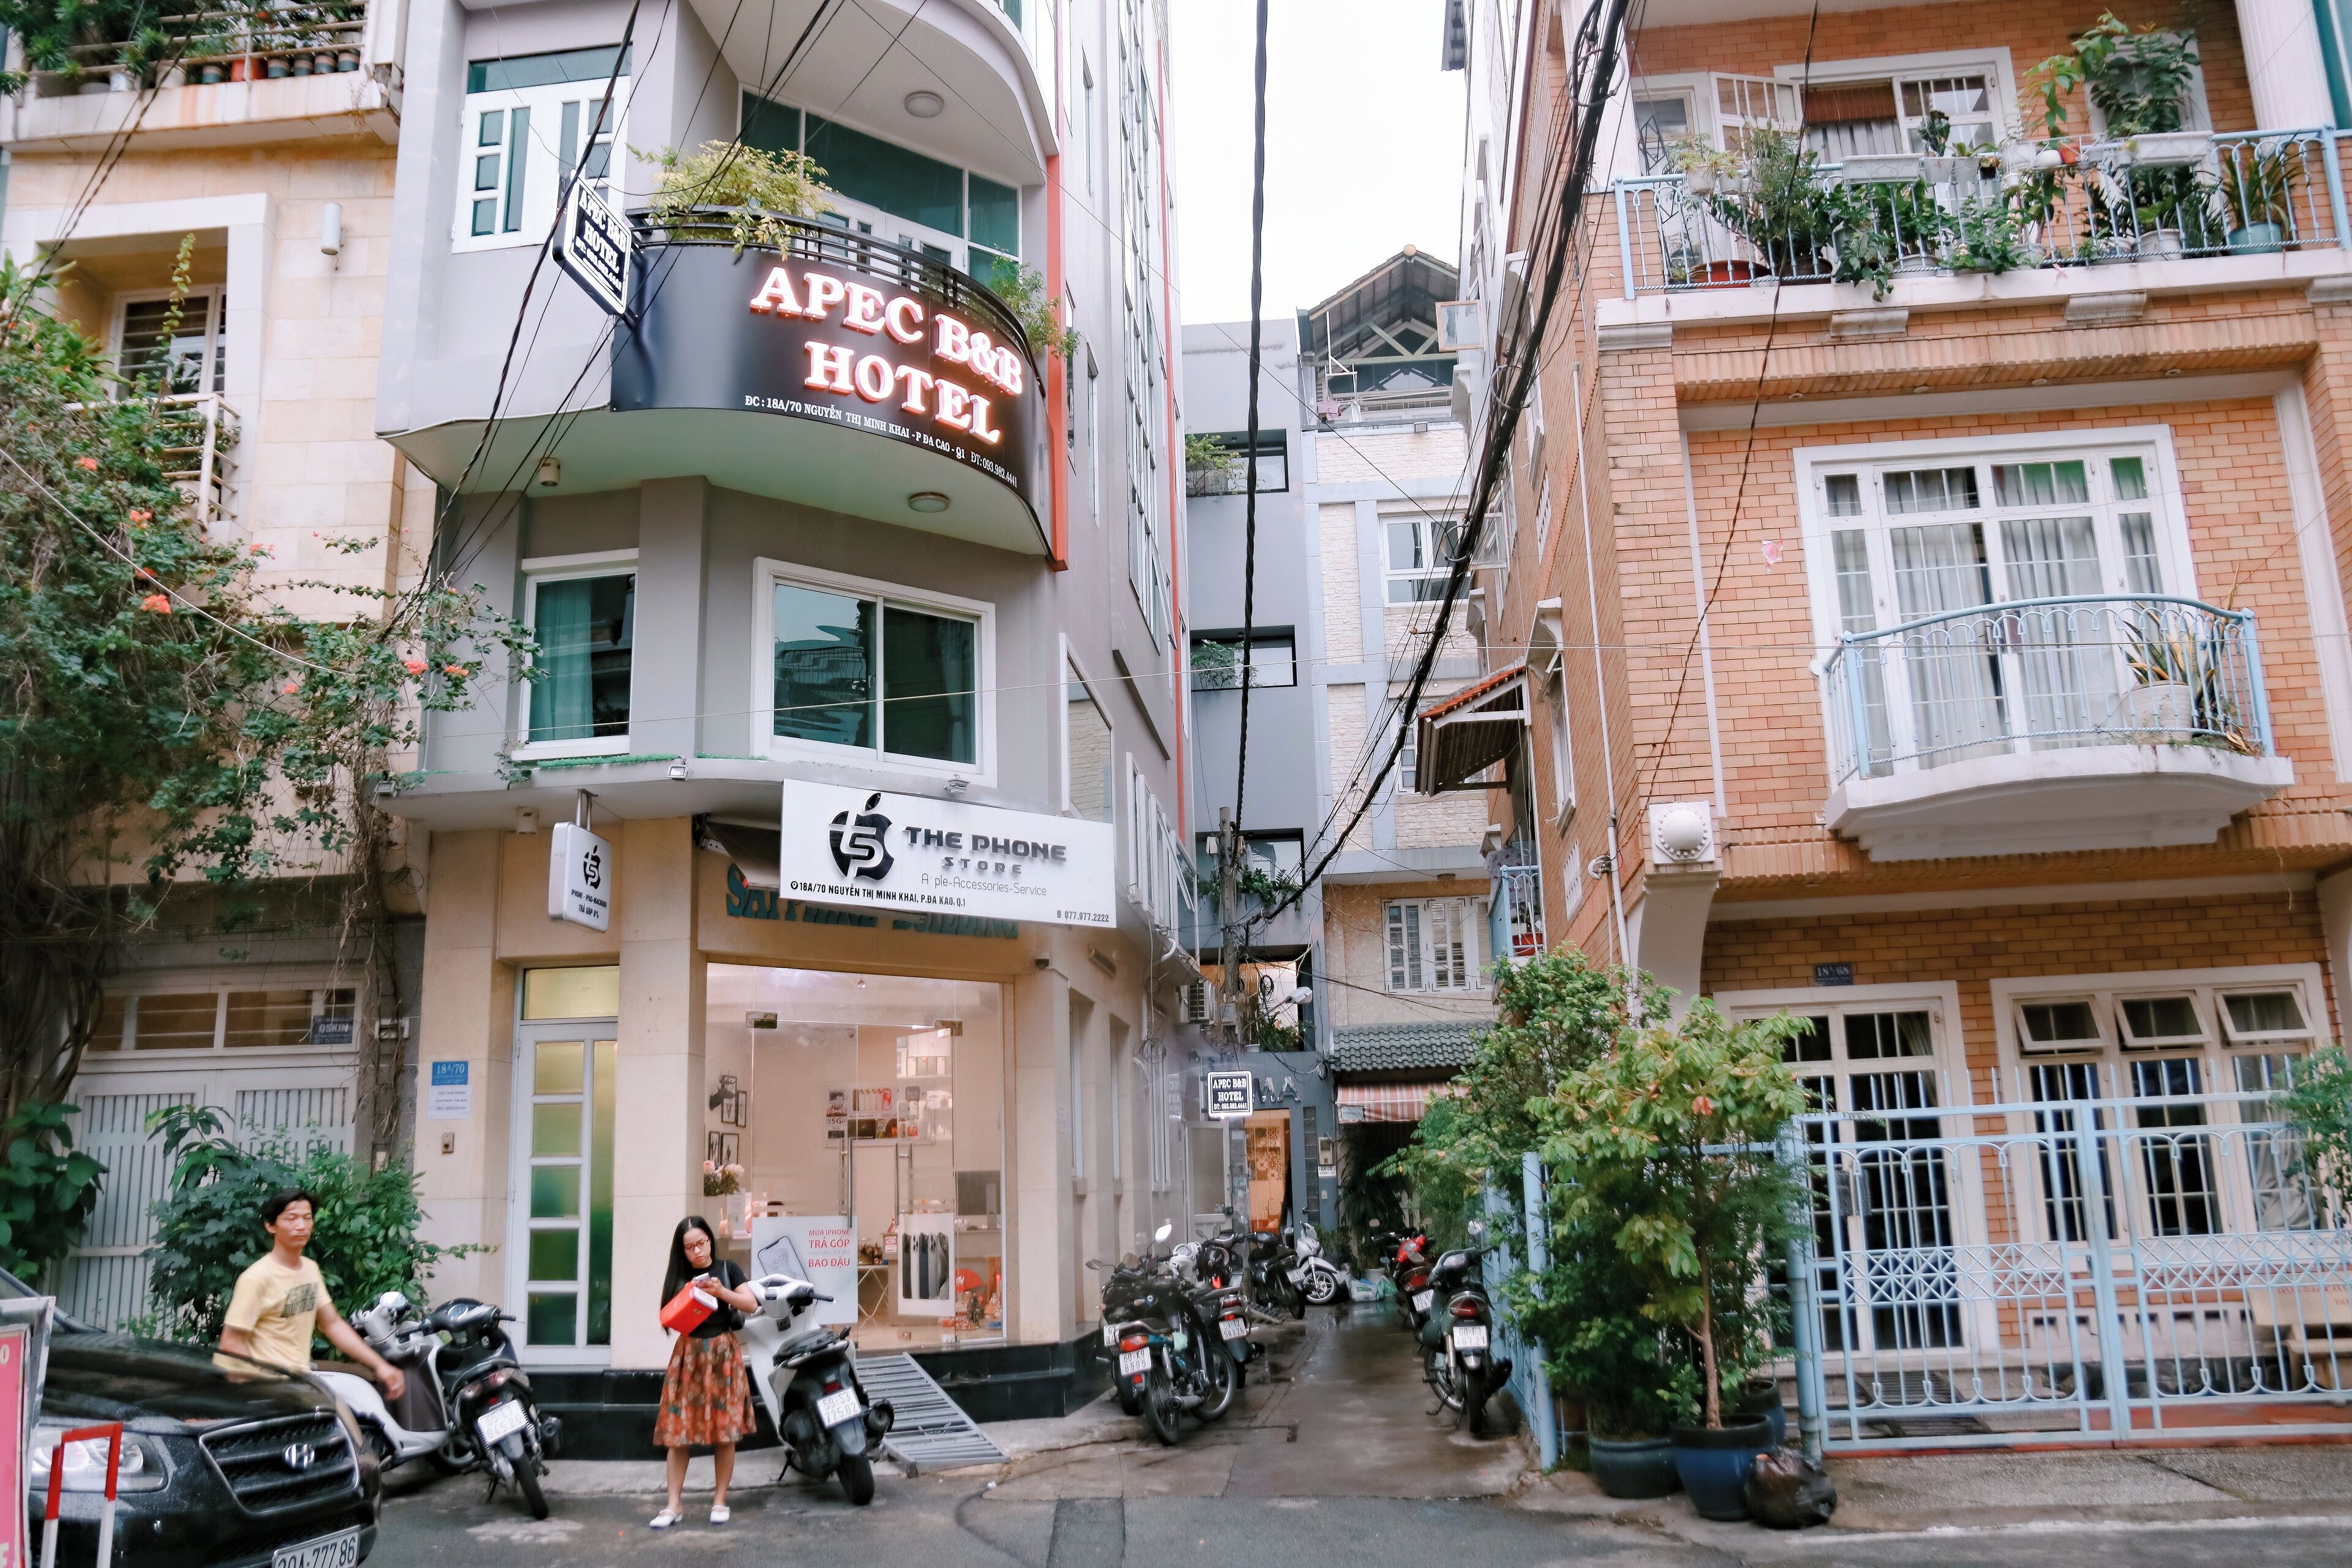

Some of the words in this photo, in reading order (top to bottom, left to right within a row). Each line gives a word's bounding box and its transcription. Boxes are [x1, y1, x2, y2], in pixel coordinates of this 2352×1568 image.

[579, 189, 606, 230] APEC
[607, 216, 627, 252] B&B
[584, 221, 619, 274] HOTEL
[750, 266, 924, 344] APEC
[934, 313, 1022, 396] B&B
[804, 341, 1001, 445] HOTEL
[767, 398, 802, 412] 18A/70
[804, 404, 842, 420] NGUYỄN
[846, 412, 861, 427] THỊ
[864, 416, 886, 432] MINH
[889, 423, 910, 439] KHAI
[923, 435, 934, 447] ĐA
[936, 439, 950, 452] CAO
[956, 447, 965, 459] Q1
[982, 458, 1017, 488] 093.982.4441
[903, 826, 962, 850] THE
[971, 834, 1066, 862] PHONE
[943, 856, 1022, 874] STORE
[921, 873, 1047, 896] Aple-Accessories-Service
[799, 882, 826, 893] 18A/70
[828, 883, 859, 897] NGUYỄN
[862, 888, 873, 900] THỊ
[876, 891, 896, 900] MINH
[899, 892, 919, 903] KHAI,
[921, 895, 937, 904] P.ĐA
[939, 895, 955, 906] KAO,
[957, 898, 965, 907] Q.1
[1065, 911, 1109, 922] 077.977.2222
[319, 1023, 349, 1033] QSKIN
[437, 1063, 465, 1074] 18A/70
[1213, 1078, 1231, 1088] APEC
[1232, 1077, 1246, 1088] B&B
[1218, 1091, 1243, 1101] HOTEL
[809, 1237, 827, 1248] TRẢ
[830, 1237, 850, 1248] GÓP
[809, 1259, 828, 1267] BAO
[831, 1256, 850, 1268] ĐẬU
[823, 1391, 850, 1410] 59-S3
